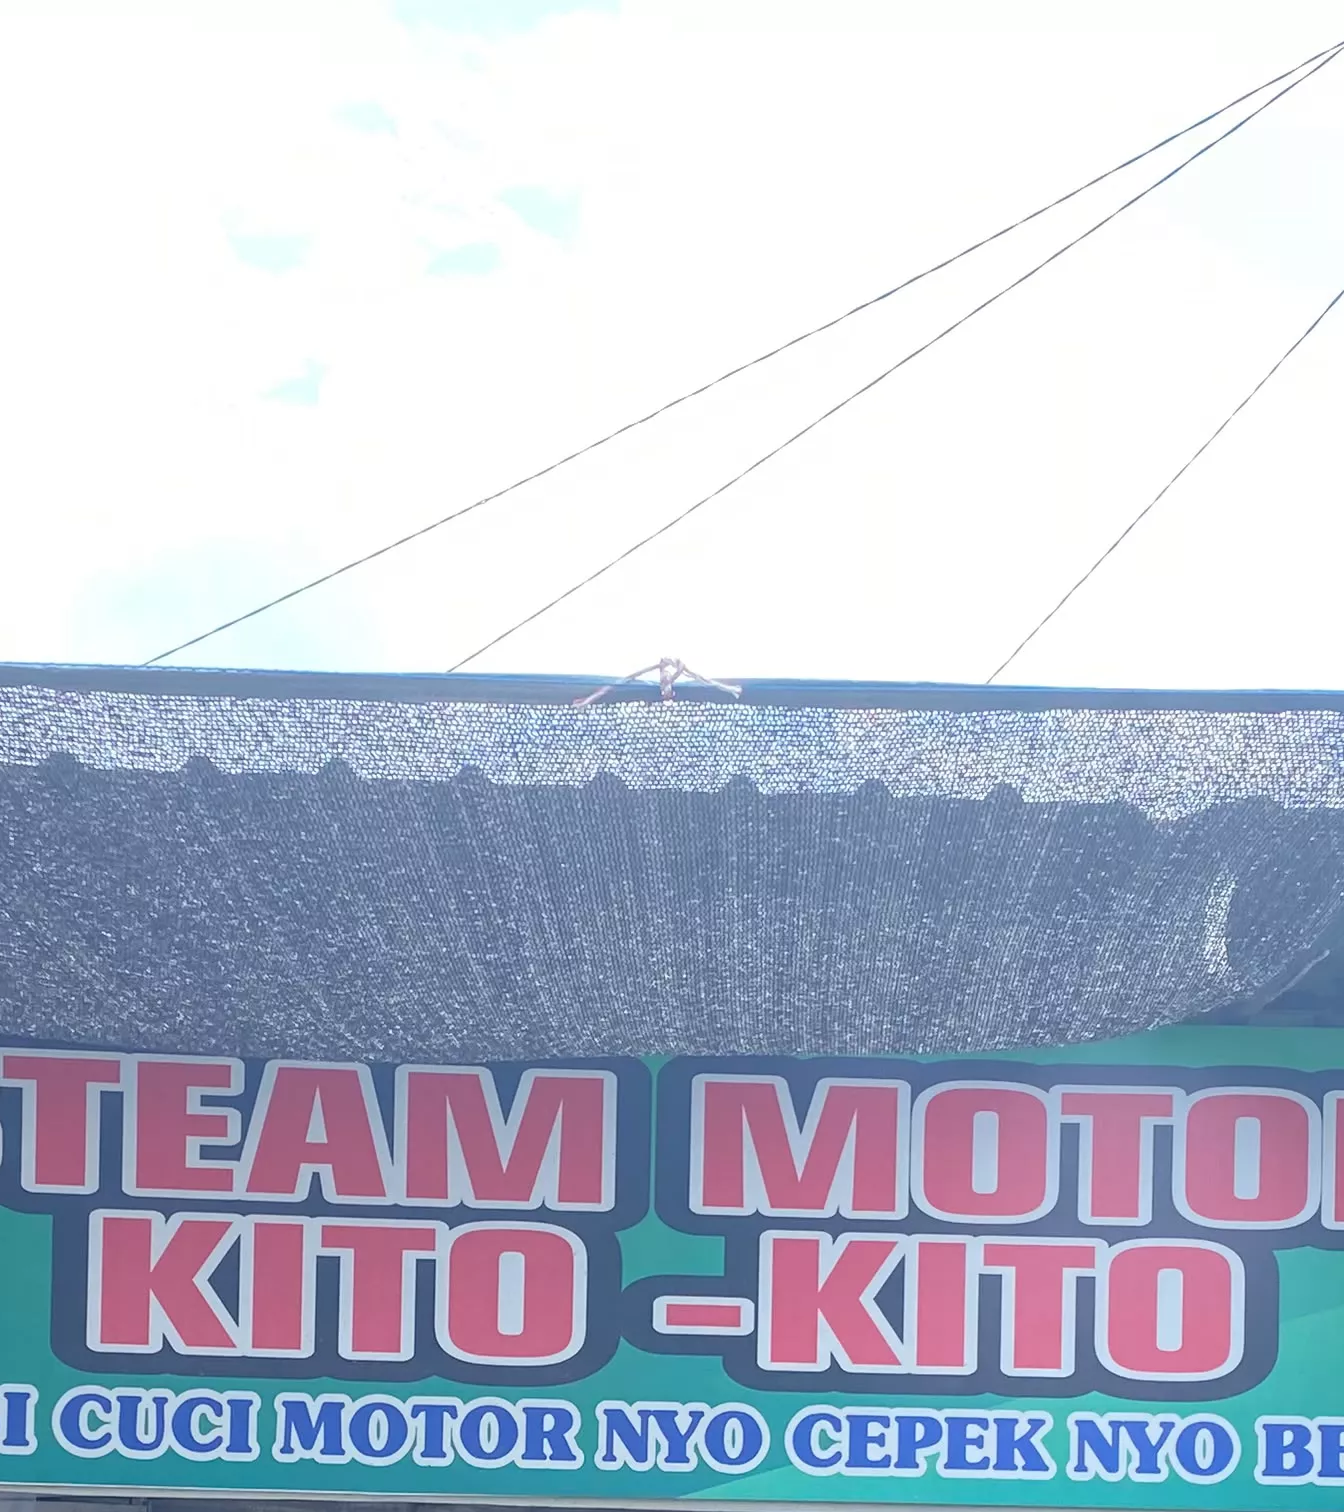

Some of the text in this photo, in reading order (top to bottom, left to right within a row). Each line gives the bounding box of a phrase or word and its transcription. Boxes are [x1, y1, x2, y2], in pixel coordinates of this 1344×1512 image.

[85, 1208, 588, 1367] KITO
[55, 1385, 260, 1463] CUCI
[272, 1392, 585, 1472] MOTOR
[594, 1398, 770, 1478] NYO
[786, 1403, 1057, 1480] CEPEK
[1066, 1411, 1242, 1485] NYO
